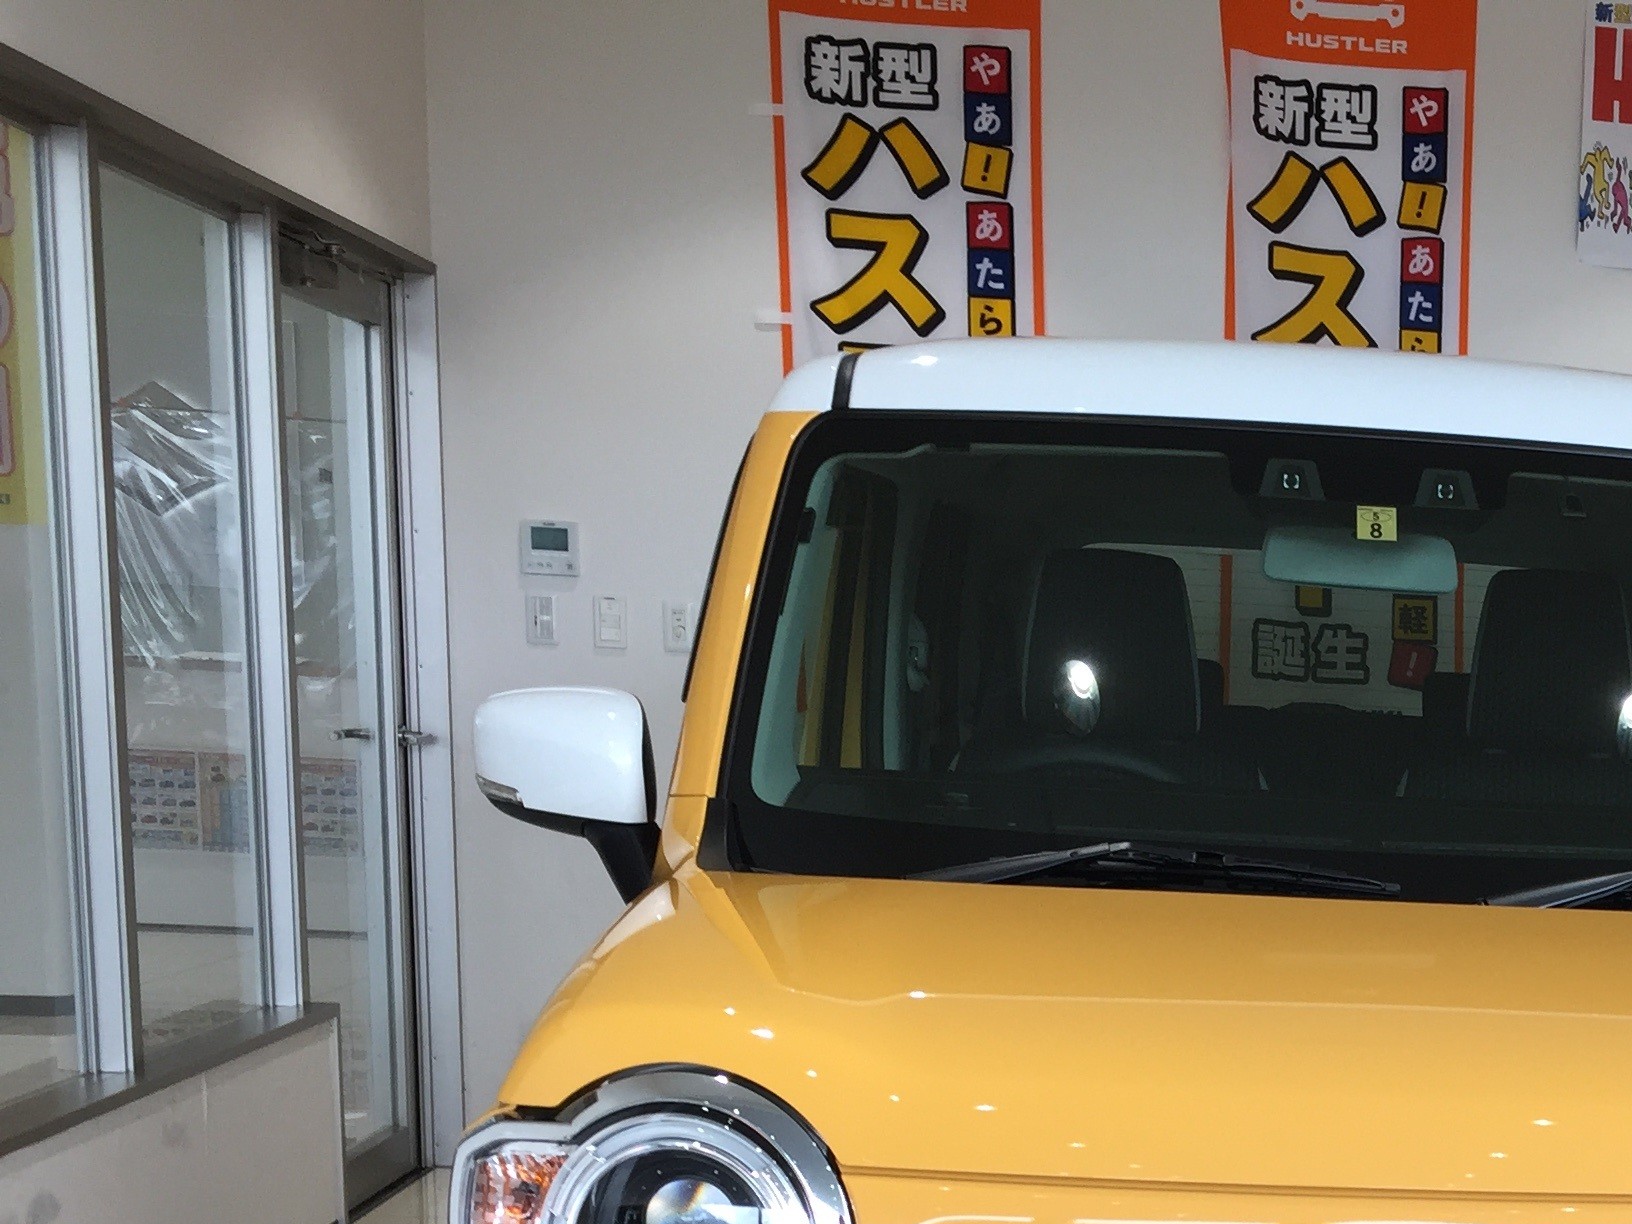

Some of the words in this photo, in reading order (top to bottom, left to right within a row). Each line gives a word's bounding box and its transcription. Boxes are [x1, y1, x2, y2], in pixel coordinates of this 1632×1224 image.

[803, 34, 940, 111] 新型
[1285, 30, 1408, 55] HUSTLER
[1253, 74, 1379, 151] 新型
[800, 111, 951, 350] ハス
[1246, 149, 1387, 348] ハス
[1370, 522, 1383, 539] 8
[1372, 511, 1380, 521] 5
[1251, 617, 1370, 685] 誕生
